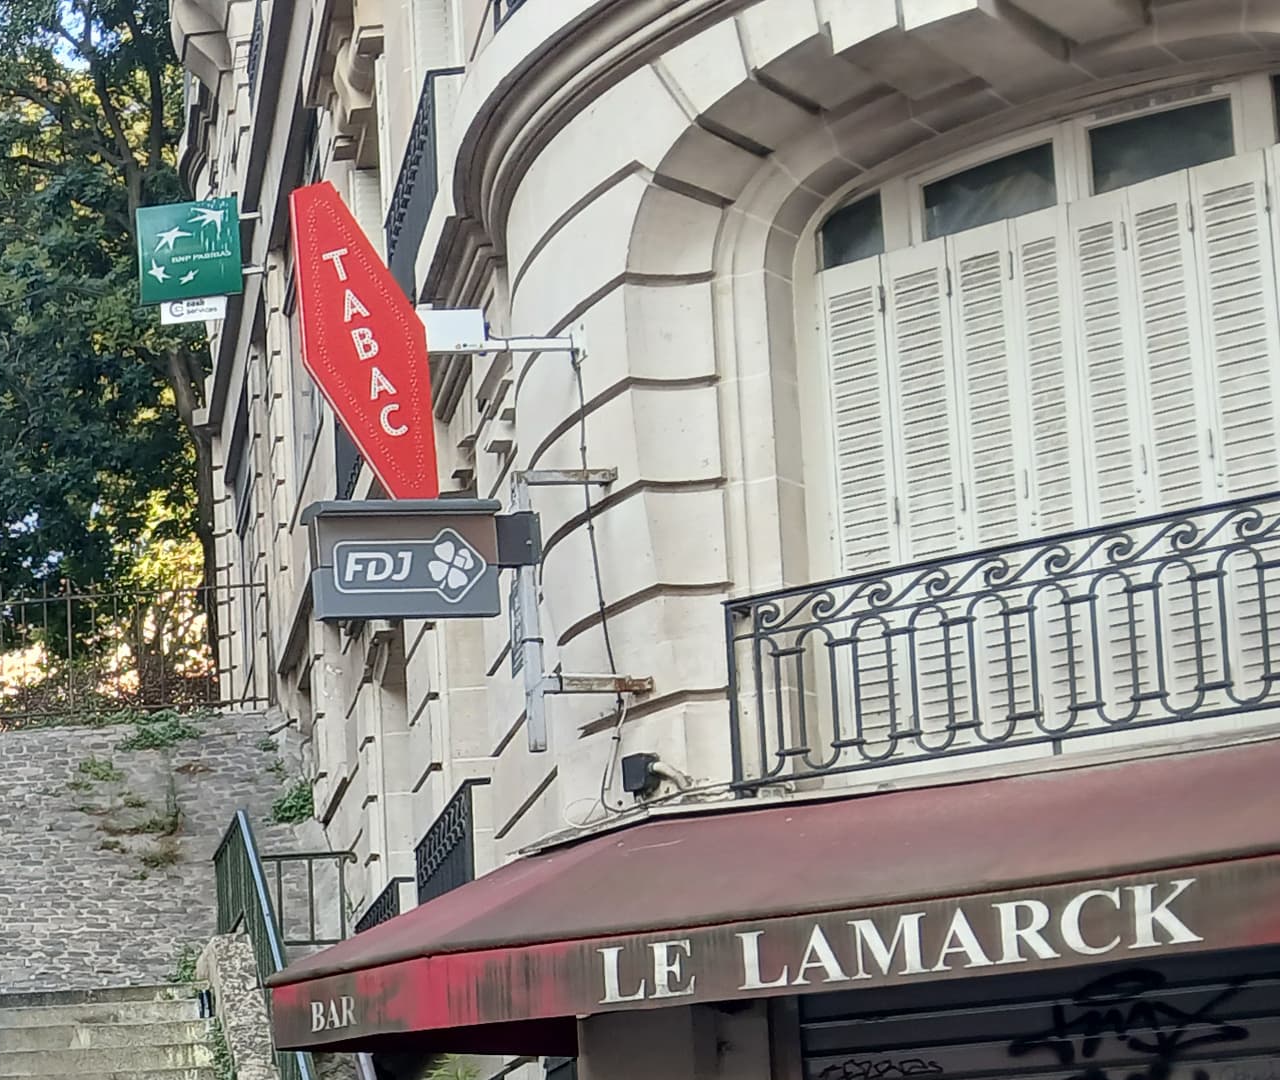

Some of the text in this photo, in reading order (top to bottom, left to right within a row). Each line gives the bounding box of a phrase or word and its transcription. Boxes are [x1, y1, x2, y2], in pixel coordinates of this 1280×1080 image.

[171, 250, 232, 263] BNP PARIBAS
[321, 247, 409, 437] TABAC
[343, 551, 414, 584] FDJ
[596, 877, 1205, 1004] LE LAMARCK
[310, 995, 356, 1033] BAR
